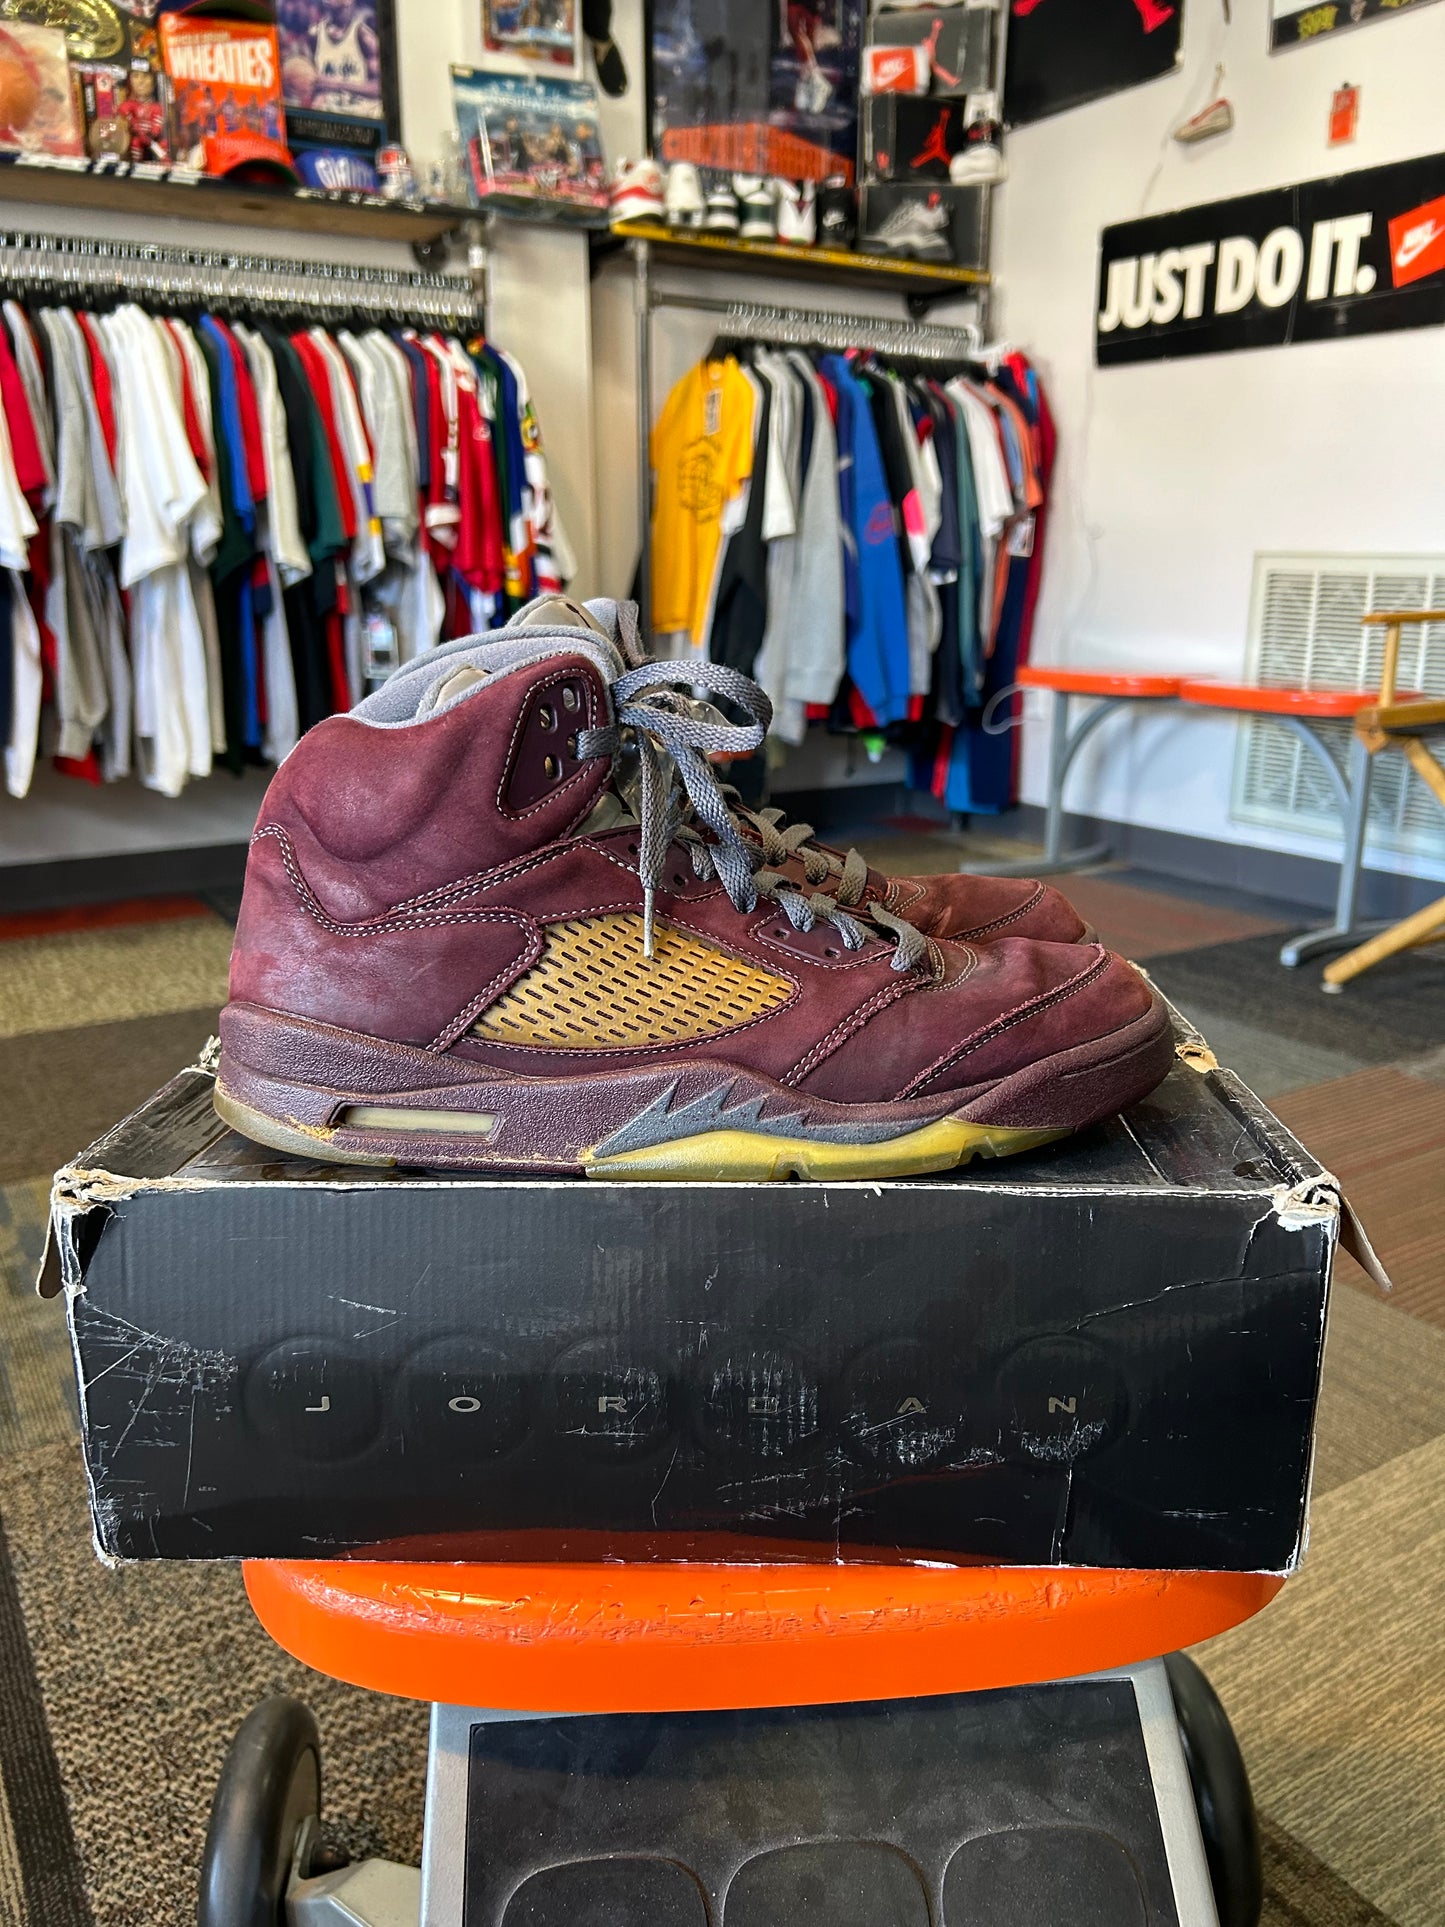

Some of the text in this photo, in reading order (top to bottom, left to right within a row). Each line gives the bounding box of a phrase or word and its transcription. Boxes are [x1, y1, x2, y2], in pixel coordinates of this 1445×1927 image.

[168, 38, 274, 88] WHEATIES
[1098, 211, 1377, 332] JUST DO IT.
